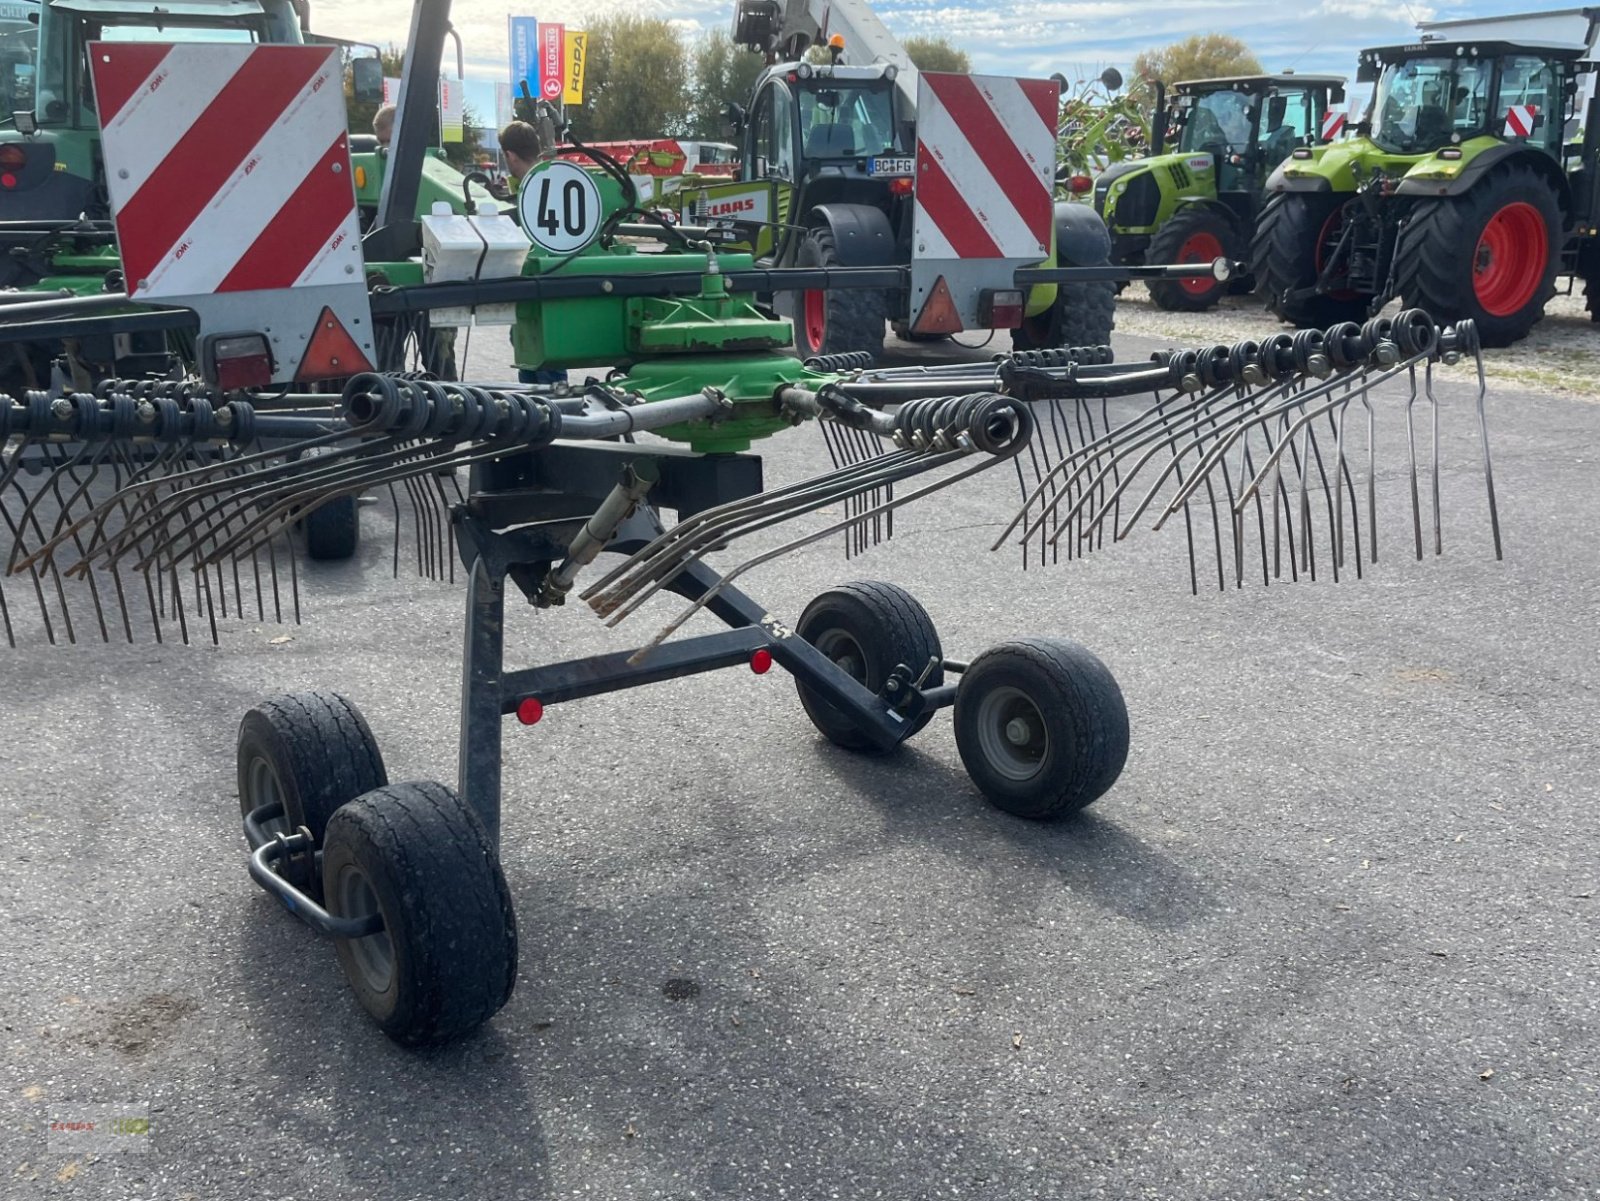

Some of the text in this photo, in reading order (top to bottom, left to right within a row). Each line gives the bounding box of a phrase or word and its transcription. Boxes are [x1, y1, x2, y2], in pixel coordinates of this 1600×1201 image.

[548, 28, 557, 76] SILOKING
[571, 35, 584, 92] ROPA
[875, 160, 911, 172] BC FG
[537, 178, 586, 237] 40
